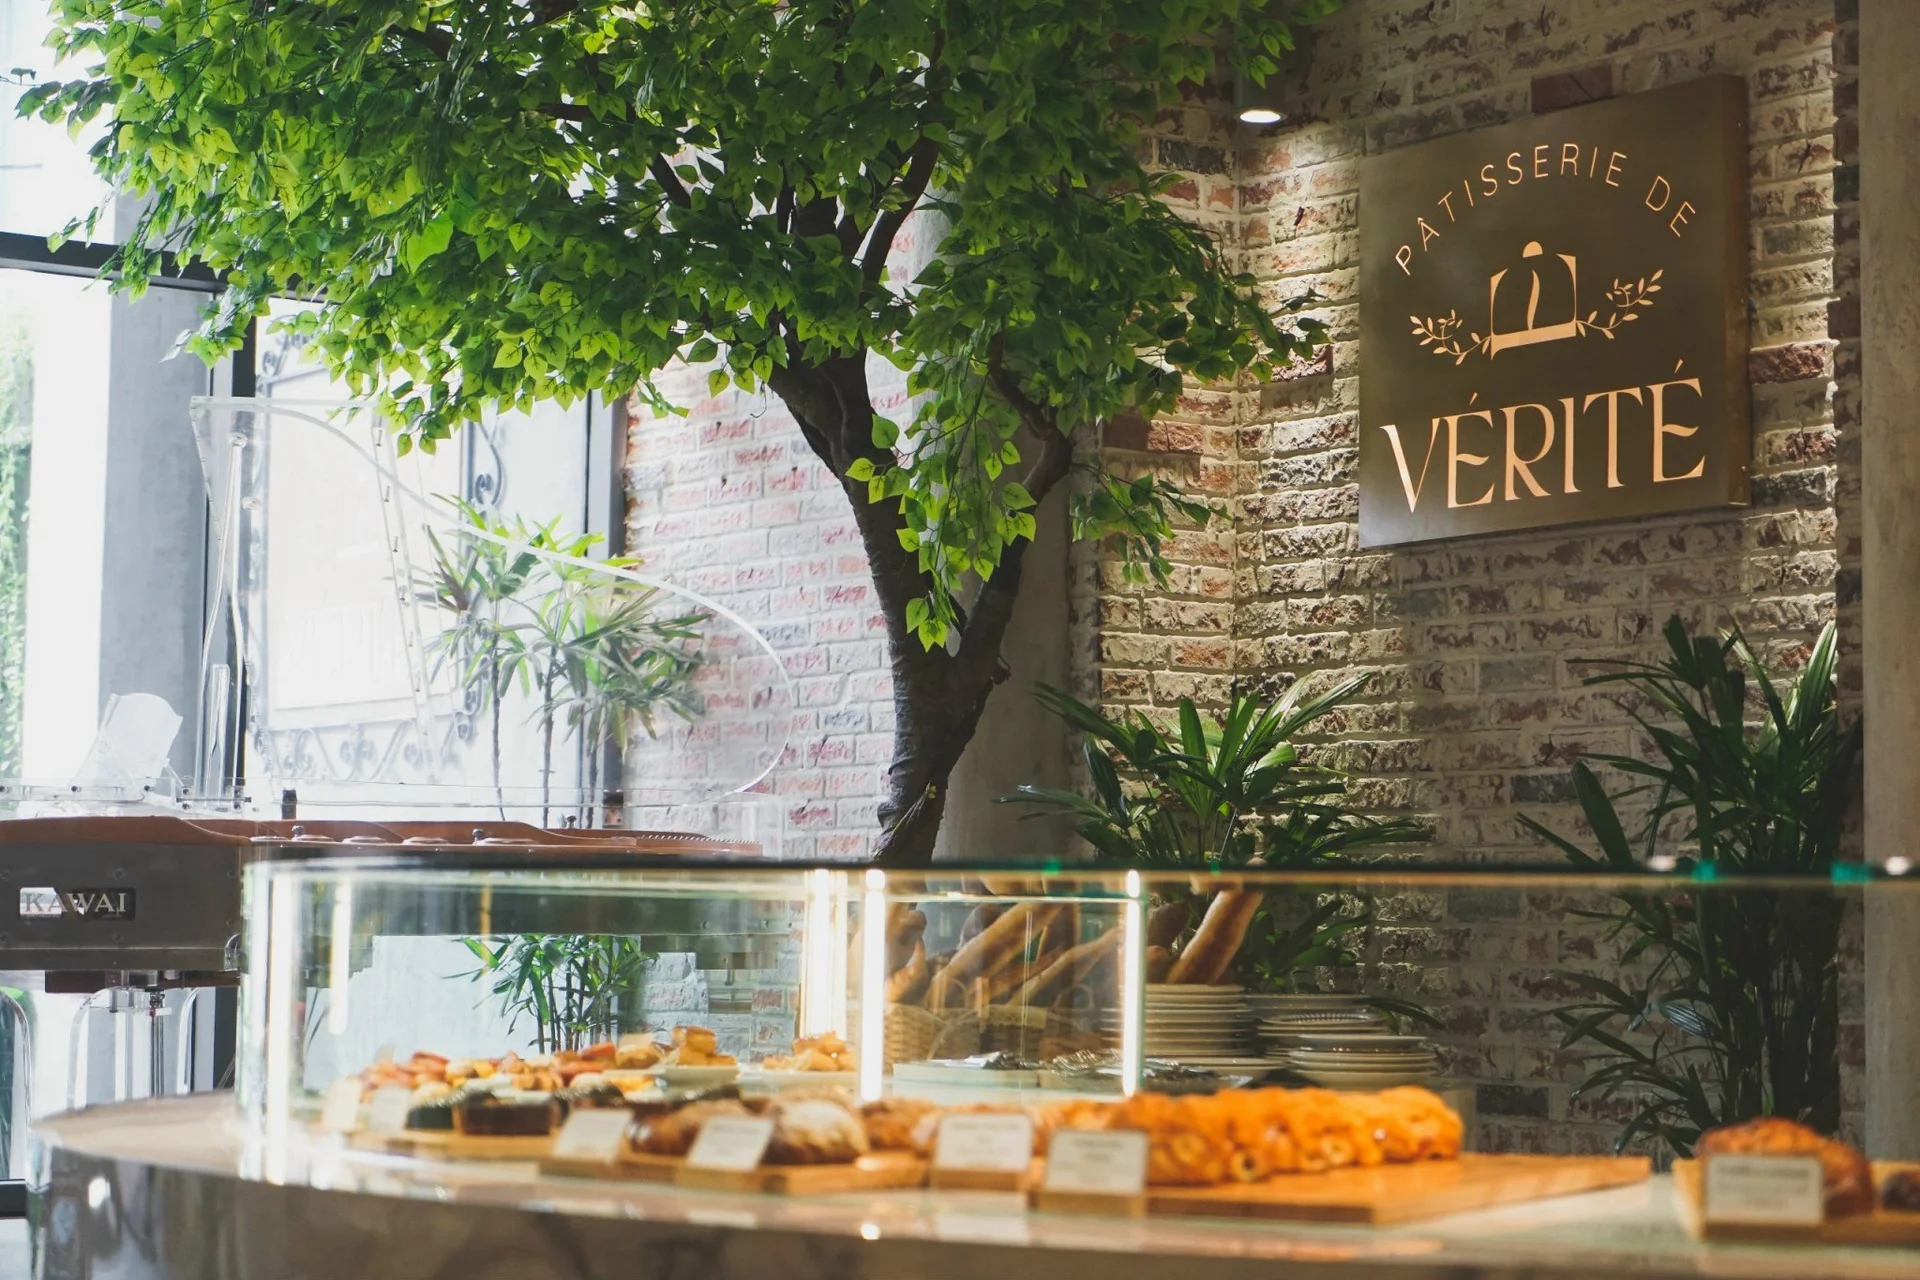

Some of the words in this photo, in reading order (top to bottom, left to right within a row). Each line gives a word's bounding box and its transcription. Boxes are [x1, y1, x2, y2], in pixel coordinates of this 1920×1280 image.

[1394, 142, 1628, 276] PÂTISSERIE
[1645, 175, 1696, 238] DE
[1378, 358, 1706, 514] VÉRITÉ
[23, 892, 128, 913] KAWAI
